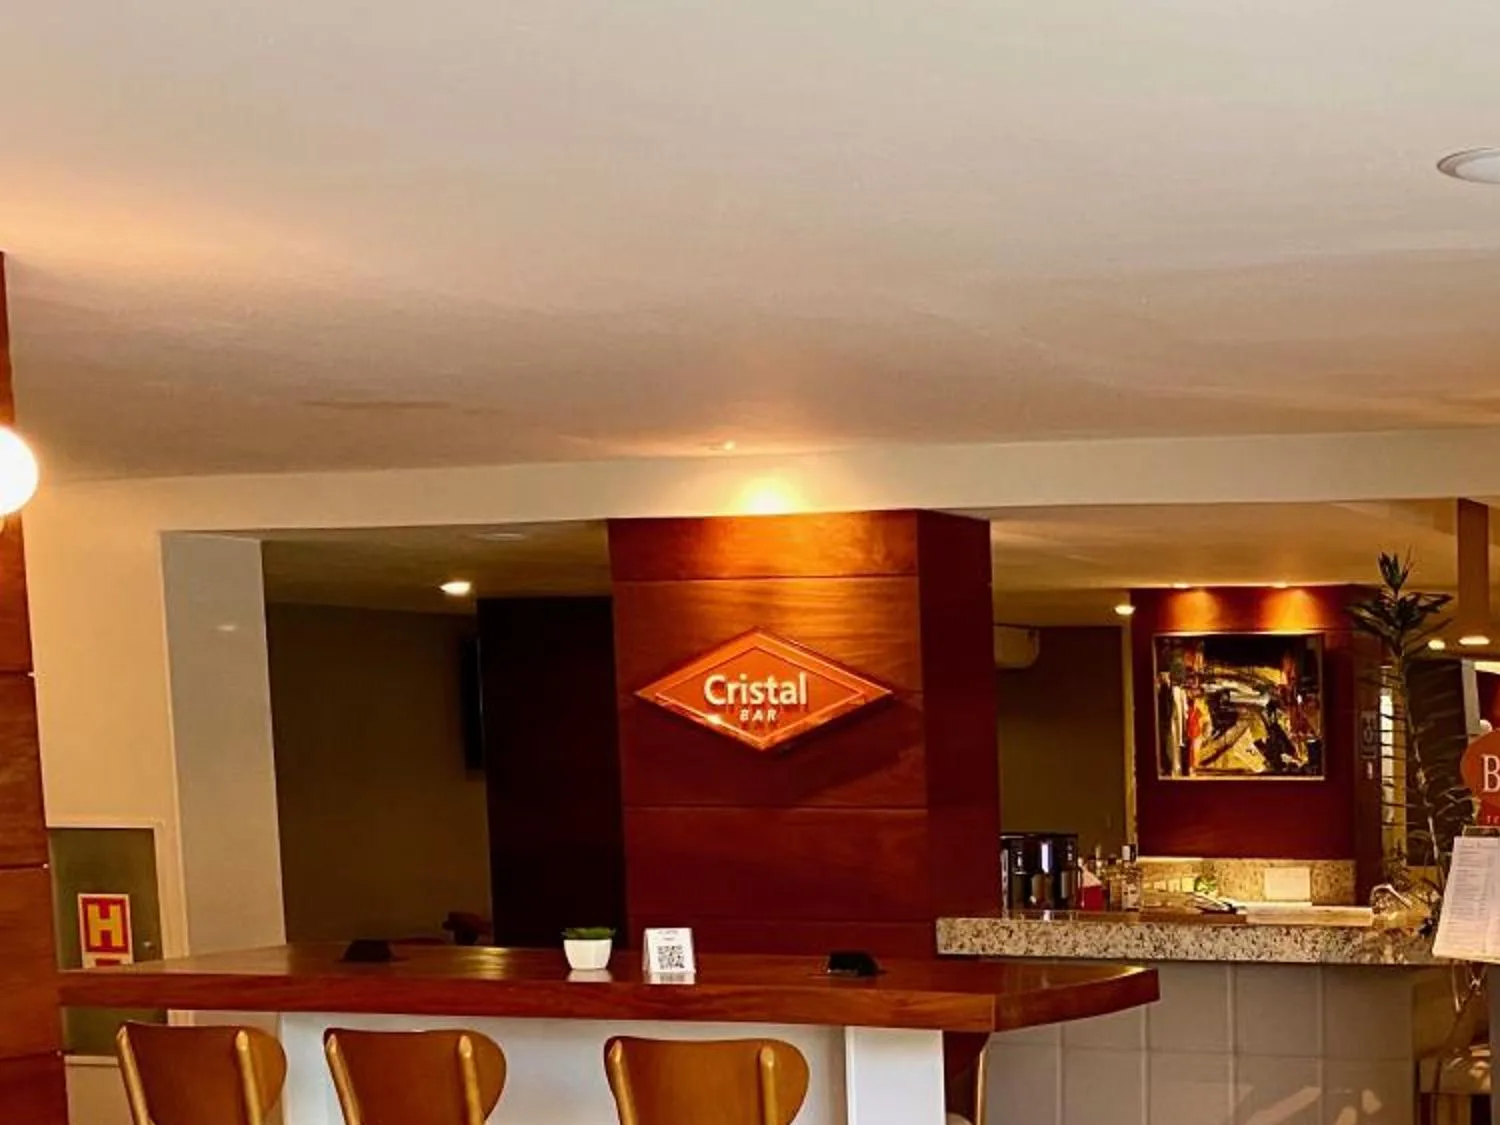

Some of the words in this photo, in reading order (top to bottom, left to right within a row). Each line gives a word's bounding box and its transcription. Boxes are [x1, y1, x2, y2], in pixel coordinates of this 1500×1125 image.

[703, 672, 808, 705] Cristal
[739, 709, 777, 722] BAR
[87, 904, 125, 947] H
